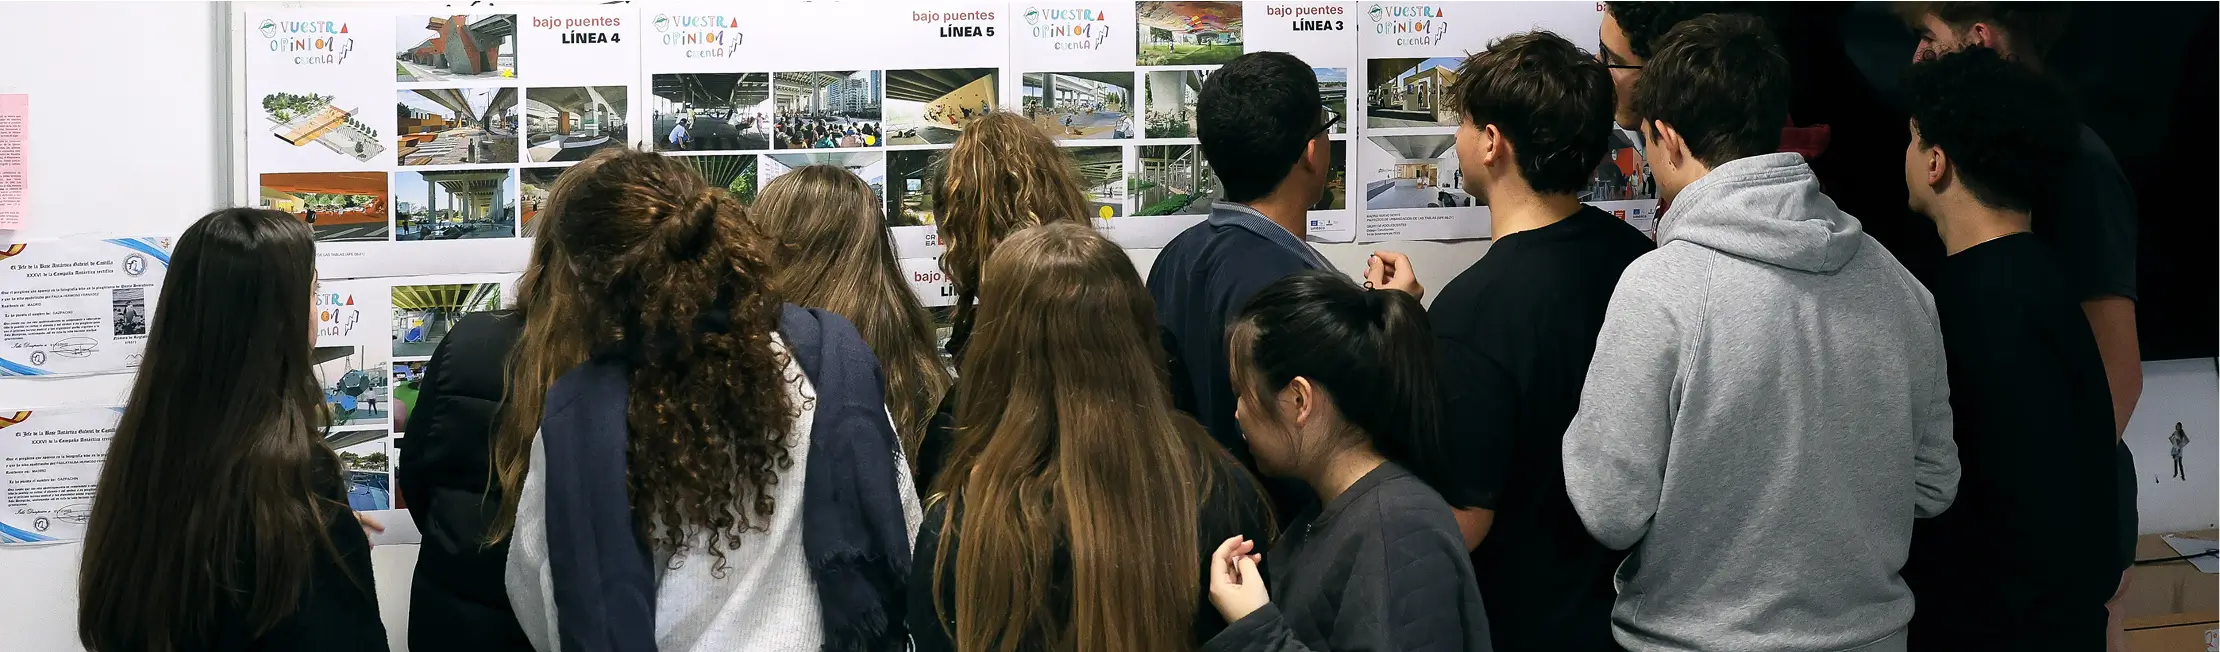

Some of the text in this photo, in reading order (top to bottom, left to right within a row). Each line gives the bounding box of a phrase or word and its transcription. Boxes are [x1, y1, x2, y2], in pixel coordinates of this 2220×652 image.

[912, 10, 995, 24] bajo puentes
[1267, 5, 1344, 18] bajo puentes
[533, 16, 621, 30] bajo puentes
[1292, 18, 1344, 31] LÍNEA 3
[562, 30, 621, 44] LÍNEA 4
[940, 24, 995, 38] LÍNEA 5
[914, 271, 941, 284] bajo
[316, 293, 354, 306] STRA
